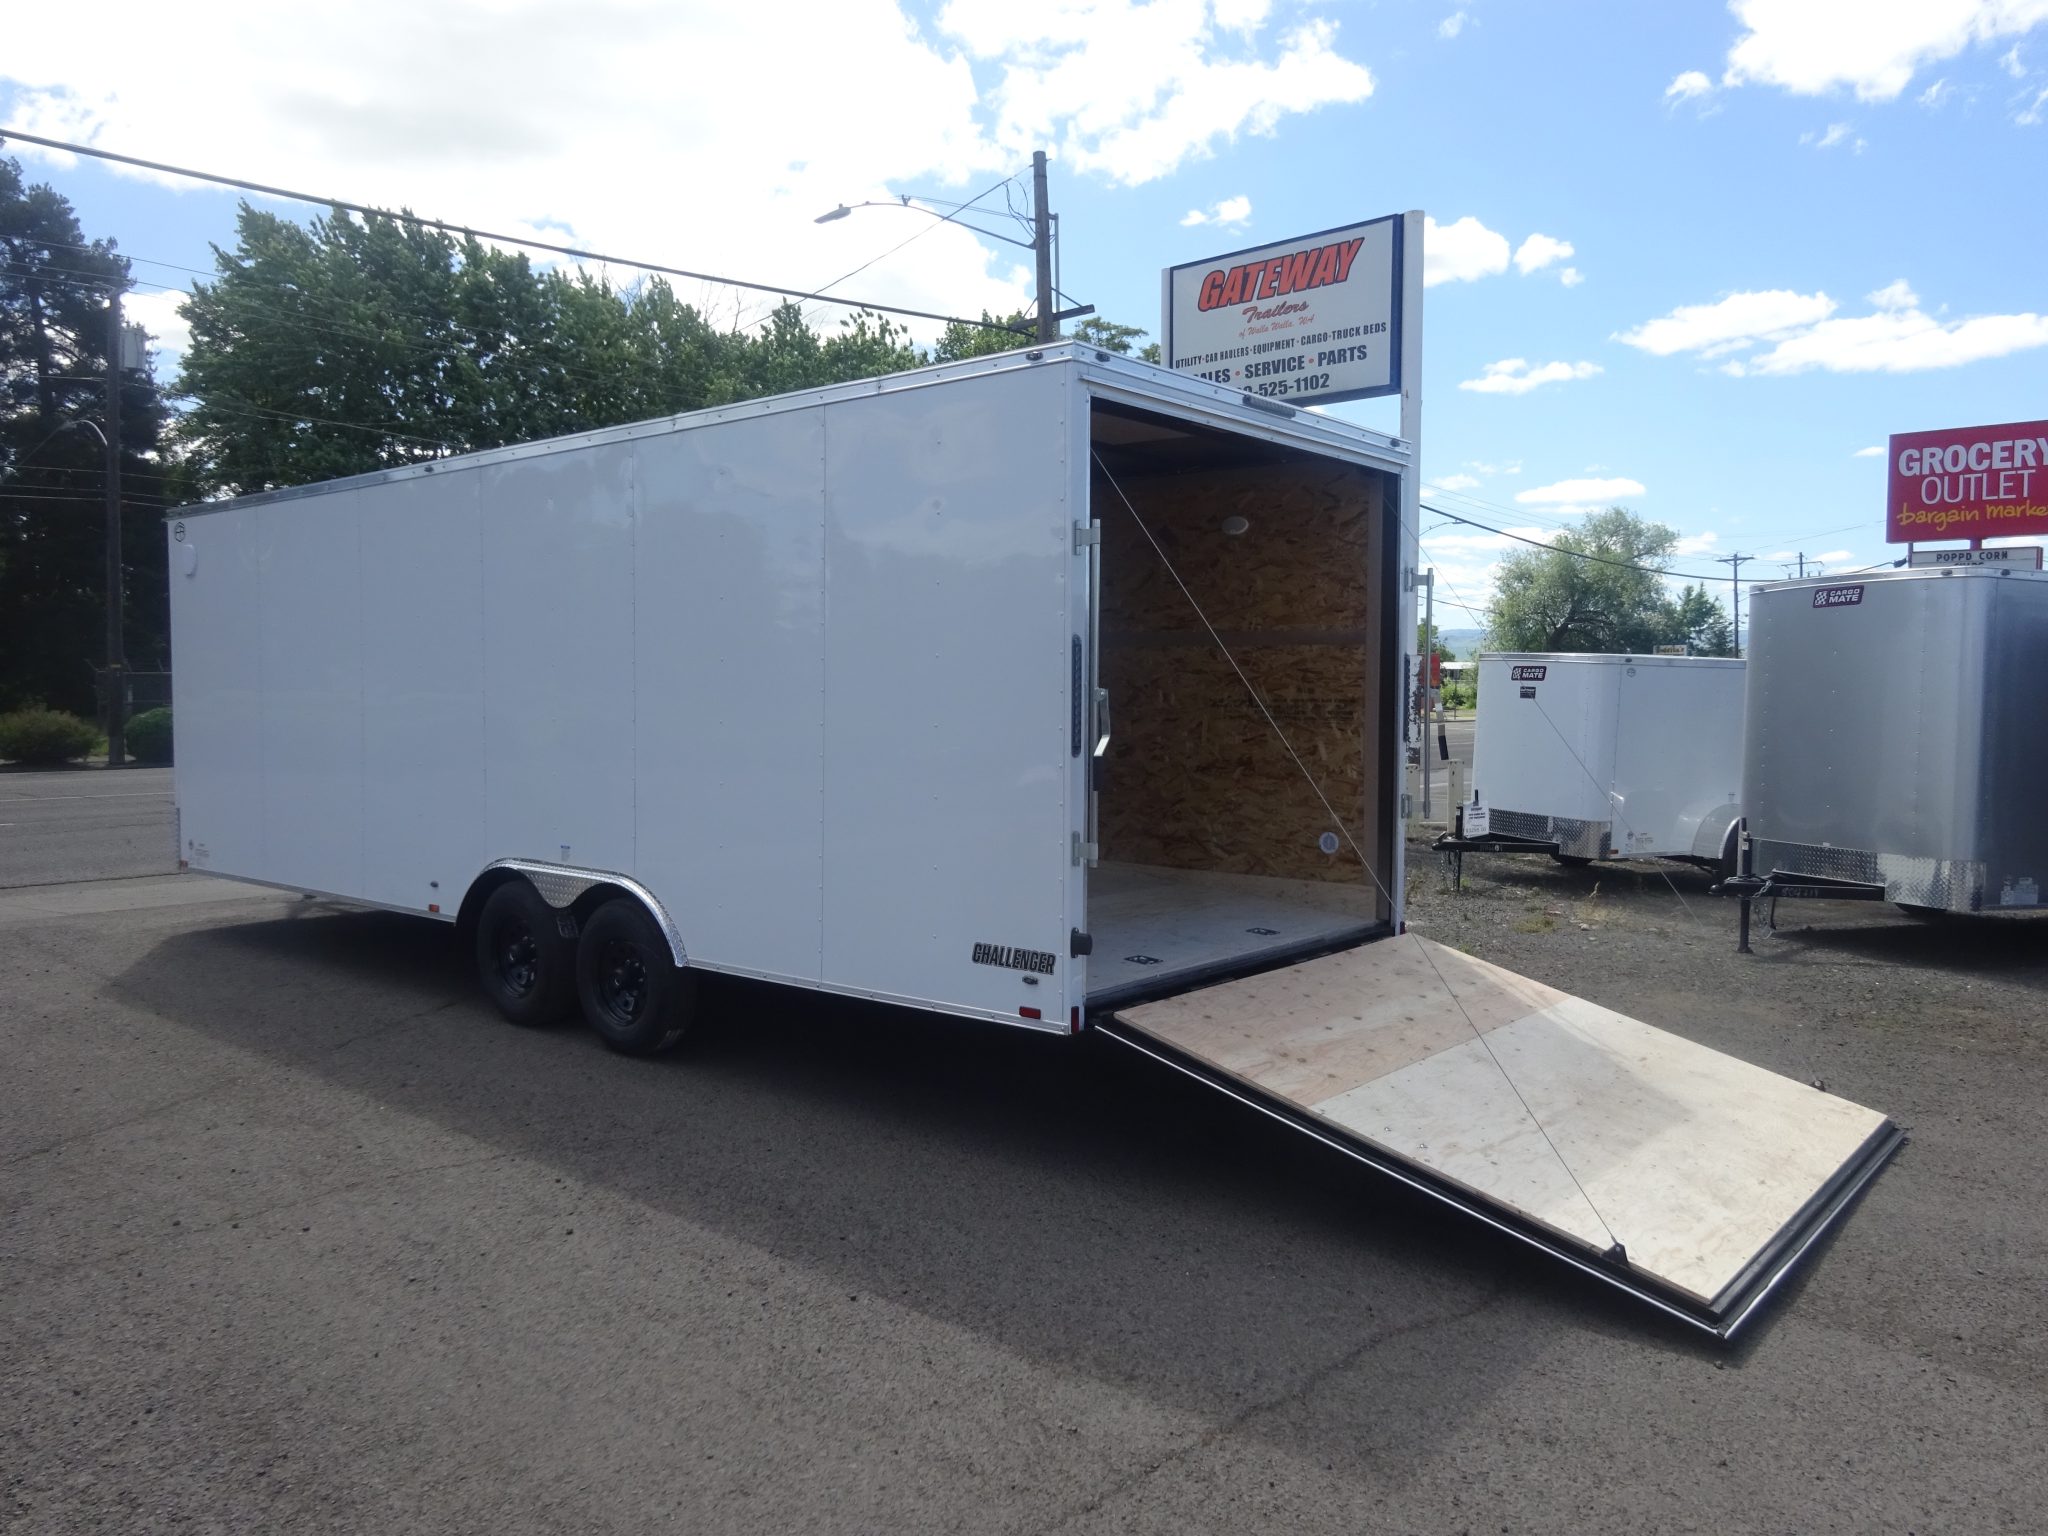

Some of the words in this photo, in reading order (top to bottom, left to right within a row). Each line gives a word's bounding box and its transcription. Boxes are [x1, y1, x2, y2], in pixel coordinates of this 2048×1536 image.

[1197, 236, 1366, 313] GATEWAY
[1242, 300, 1310, 324] Trailers
[1175, 355, 1203, 369] UTILITY
[1205, 352, 1218, 363] CAR
[1219, 346, 1250, 361] HAULERS
[1253, 338, 1296, 355] EQUIPMENT
[1300, 332, 1328, 346] CARGO
[1329, 326, 1361, 341] TRUCK
[1363, 322, 1387, 335] BEDS
[1193, 368, 1231, 384] ALES
[1244, 355, 1305, 379] SERVICE
[1317, 344, 1368, 367] PARTS
[1920, 469, 2036, 505] OUTLET
[1896, 502, 1979, 531] bargain
[1986, 499, 2048, 520] marke
[1936, 552, 1972, 562] POPPD
[1979, 550, 2008, 561] CORN
[1829, 594, 1859, 604] MATE
[1830, 588, 1860, 597] CARGO
[972, 941, 1057, 976] CHALLENGER
